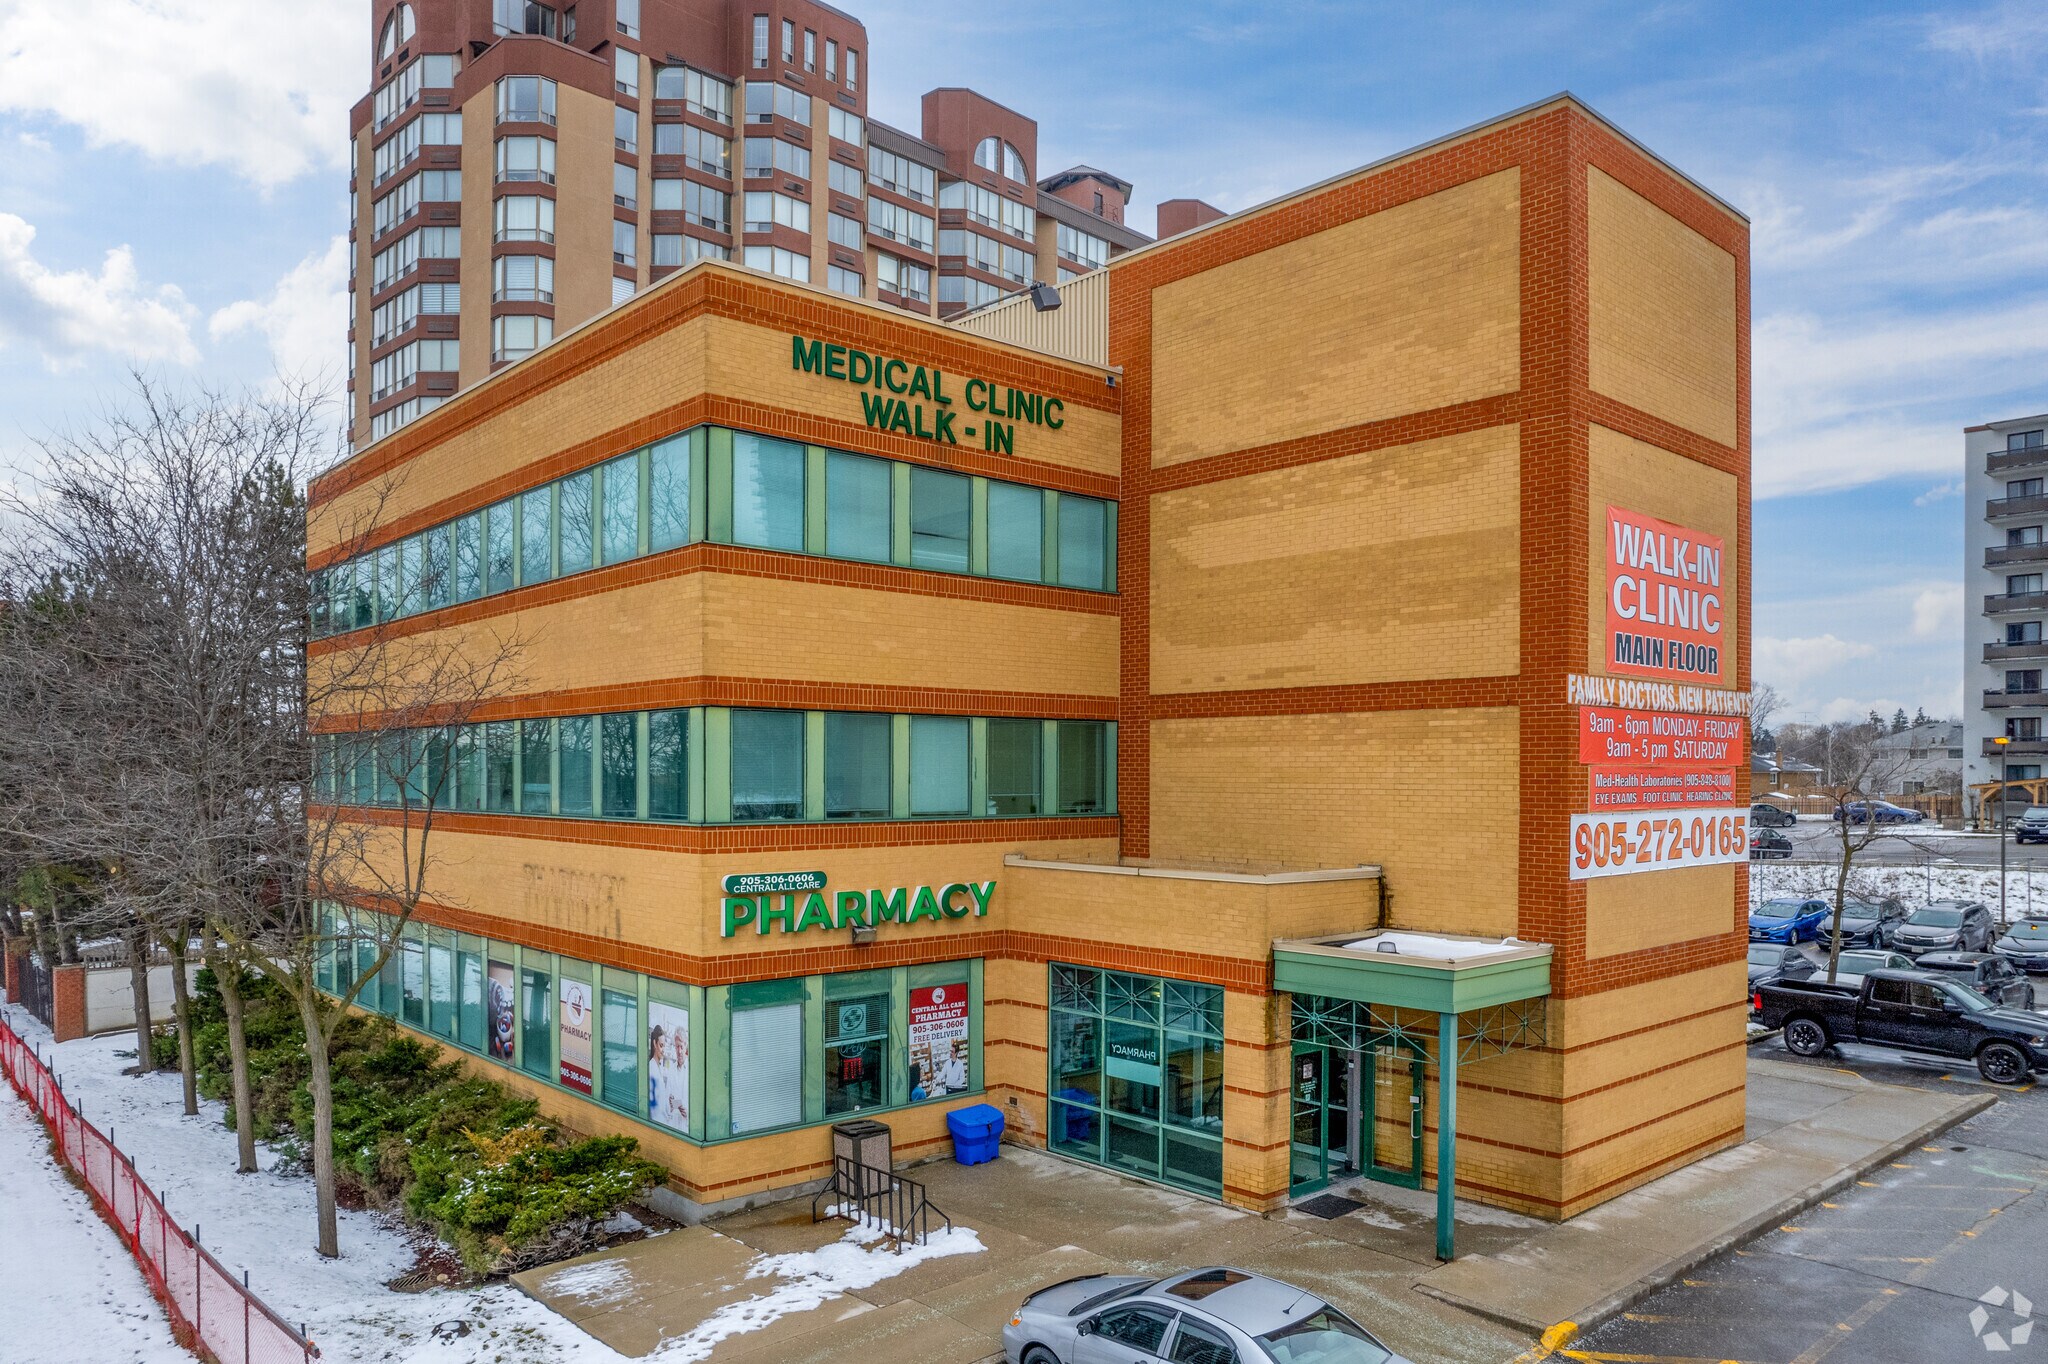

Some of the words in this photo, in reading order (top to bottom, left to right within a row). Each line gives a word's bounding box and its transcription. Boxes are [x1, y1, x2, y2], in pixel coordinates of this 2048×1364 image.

[792, 335, 952, 405] MEDICAL
[965, 378, 1065, 429] CLINIC
[861, 391, 957, 444] WALK
[985, 420, 1014, 455] IN
[1613, 520, 1720, 587] WALK-IN
[1613, 574, 1720, 634] CLINIC
[1615, 632, 1664, 669] MAIN
[1668, 640, 1718, 675] FLOOR
[1567, 673, 1616, 707] FAMILY
[1679, 685, 1702, 714] NEW
[1705, 689, 1752, 718] PATIENTS
[1589, 712, 1615, 733] 9am
[1625, 714, 1649, 739] 6pm
[1704, 720, 1740, 739] FRIDAY
[1606, 737, 1631, 757] 9am
[1641, 738, 1648, 758] 5
[1651, 743, 1668, 762] pm
[1673, 740, 1728, 760] SATURDAY
[1595, 773, 1639, 787] Med-Health
[1640, 773, 1683, 787] Laboratories
[1595, 793, 1609, 805] EYE
[1611, 792, 1637, 804] EXAMS
[1643, 792, 1661, 803] FOOT
[1686, 791, 1713, 802] HEARING
[1575, 816, 1746, 869] 905-272-0165
[733, 883, 776, 893] CENTRAL
[778, 882, 795, 890] ALL
[796, 881, 820, 889] CARE
[740, 873, 814, 885] 905-306-0606
[720, 881, 997, 938] PHARMACY
[911, 1005, 938, 1013] CENTRAL
[915, 1009, 962, 1022] PHARMACY
[560, 1023, 592, 1042] PHARMACY
[912, 1020, 964, 1034] 905-306-0606
[913, 1034, 930, 1043] FREE
[931, 1029, 963, 1039] DELIVERY
